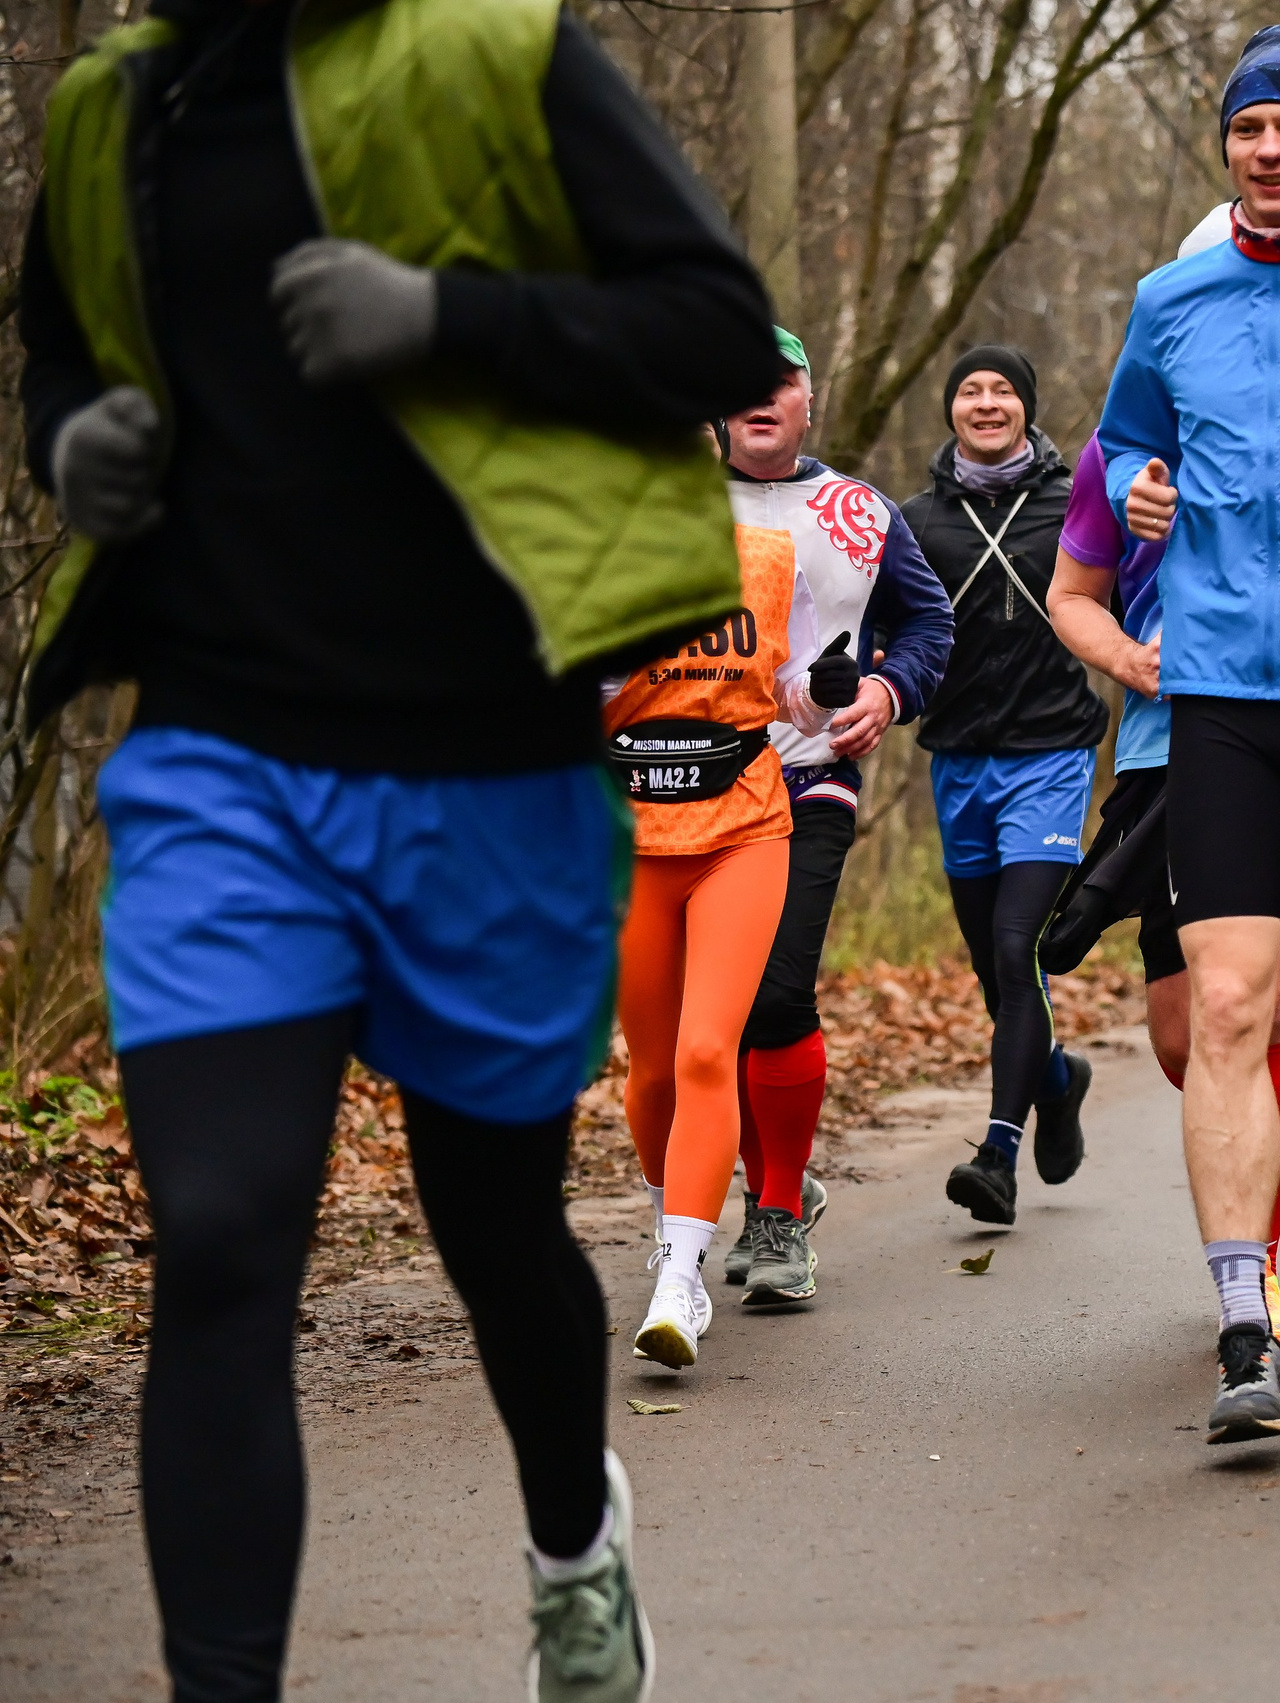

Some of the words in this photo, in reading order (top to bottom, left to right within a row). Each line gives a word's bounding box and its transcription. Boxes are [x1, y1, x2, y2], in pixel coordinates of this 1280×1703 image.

[648, 667, 682, 686] 5:30
[632, 739, 666, 751] MISSION
[667, 739, 712, 751] MARATHON
[649, 766, 701, 789] M42.2
